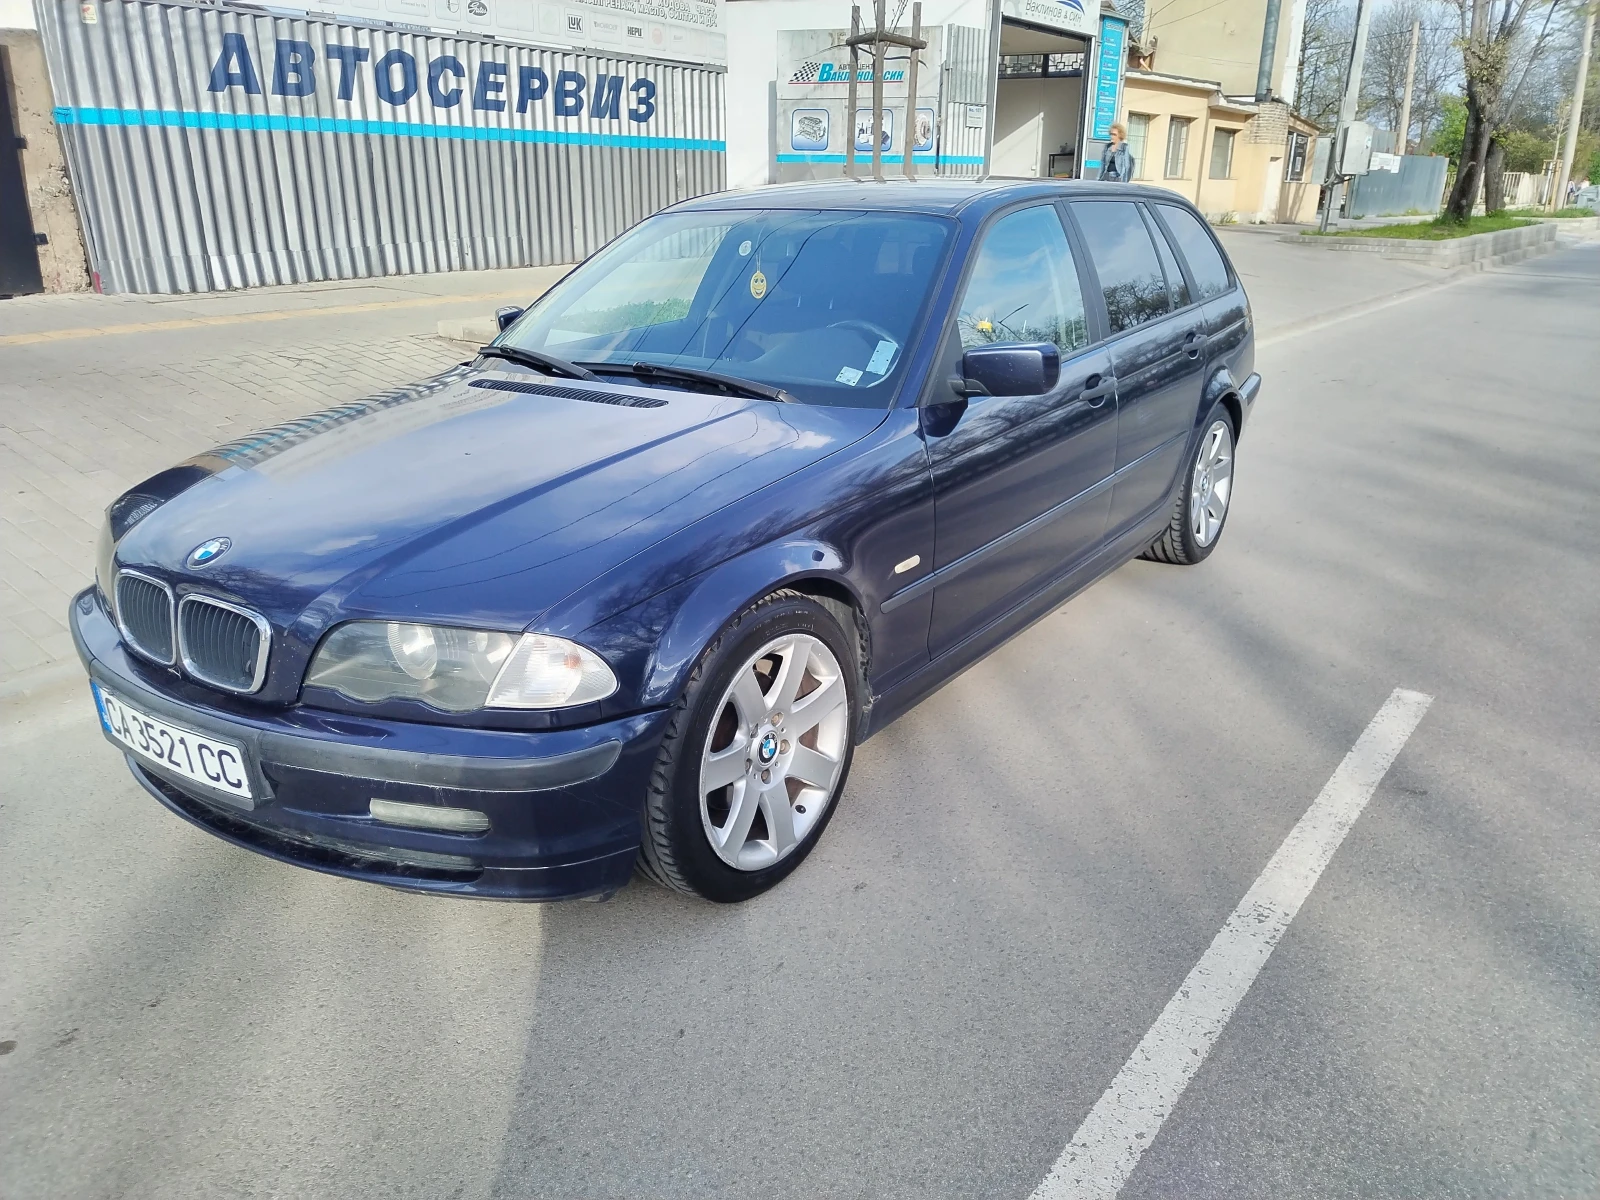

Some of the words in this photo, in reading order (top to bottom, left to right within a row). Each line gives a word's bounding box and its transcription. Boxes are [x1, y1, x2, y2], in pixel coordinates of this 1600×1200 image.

[639, 3, 667, 19] МАСЛО,
[627, 26, 642, 36] HEPU
[207, 33, 656, 123] АВТОСЕРВИЗ
